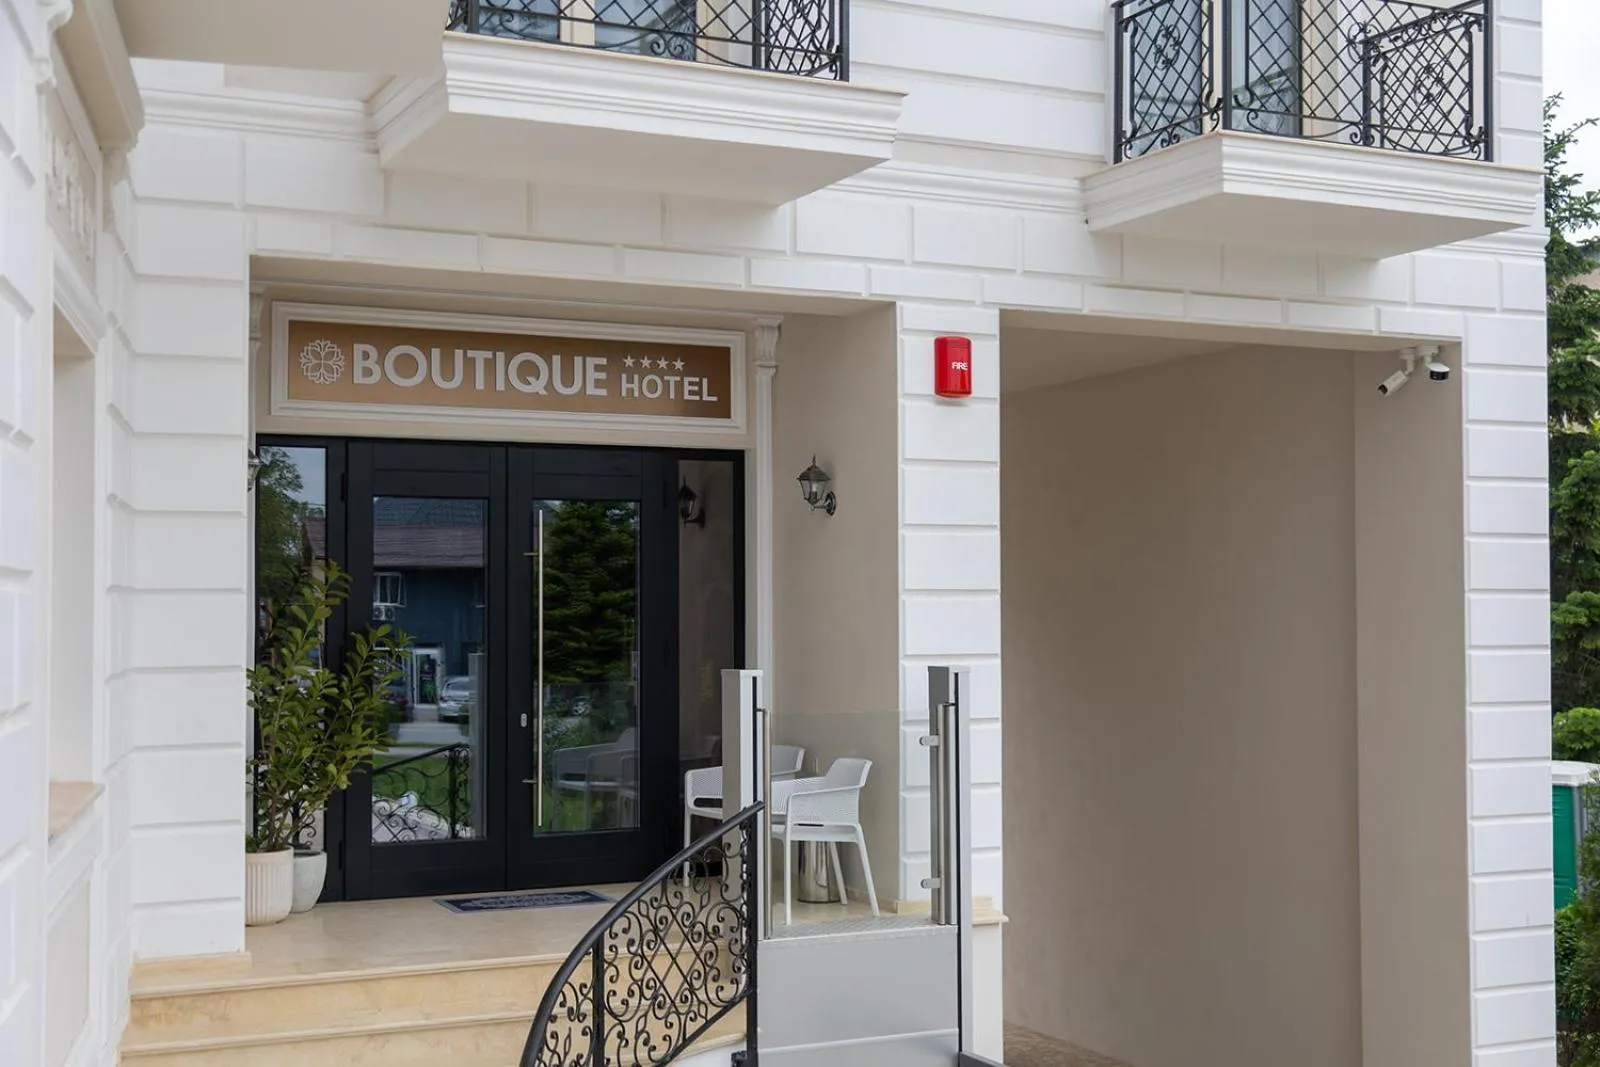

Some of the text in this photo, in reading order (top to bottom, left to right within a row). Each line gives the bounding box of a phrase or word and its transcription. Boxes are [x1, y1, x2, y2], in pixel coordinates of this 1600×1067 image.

[353, 343, 718, 401] BOUTIQUE HOTEL
[951, 361, 968, 371] FIRE
